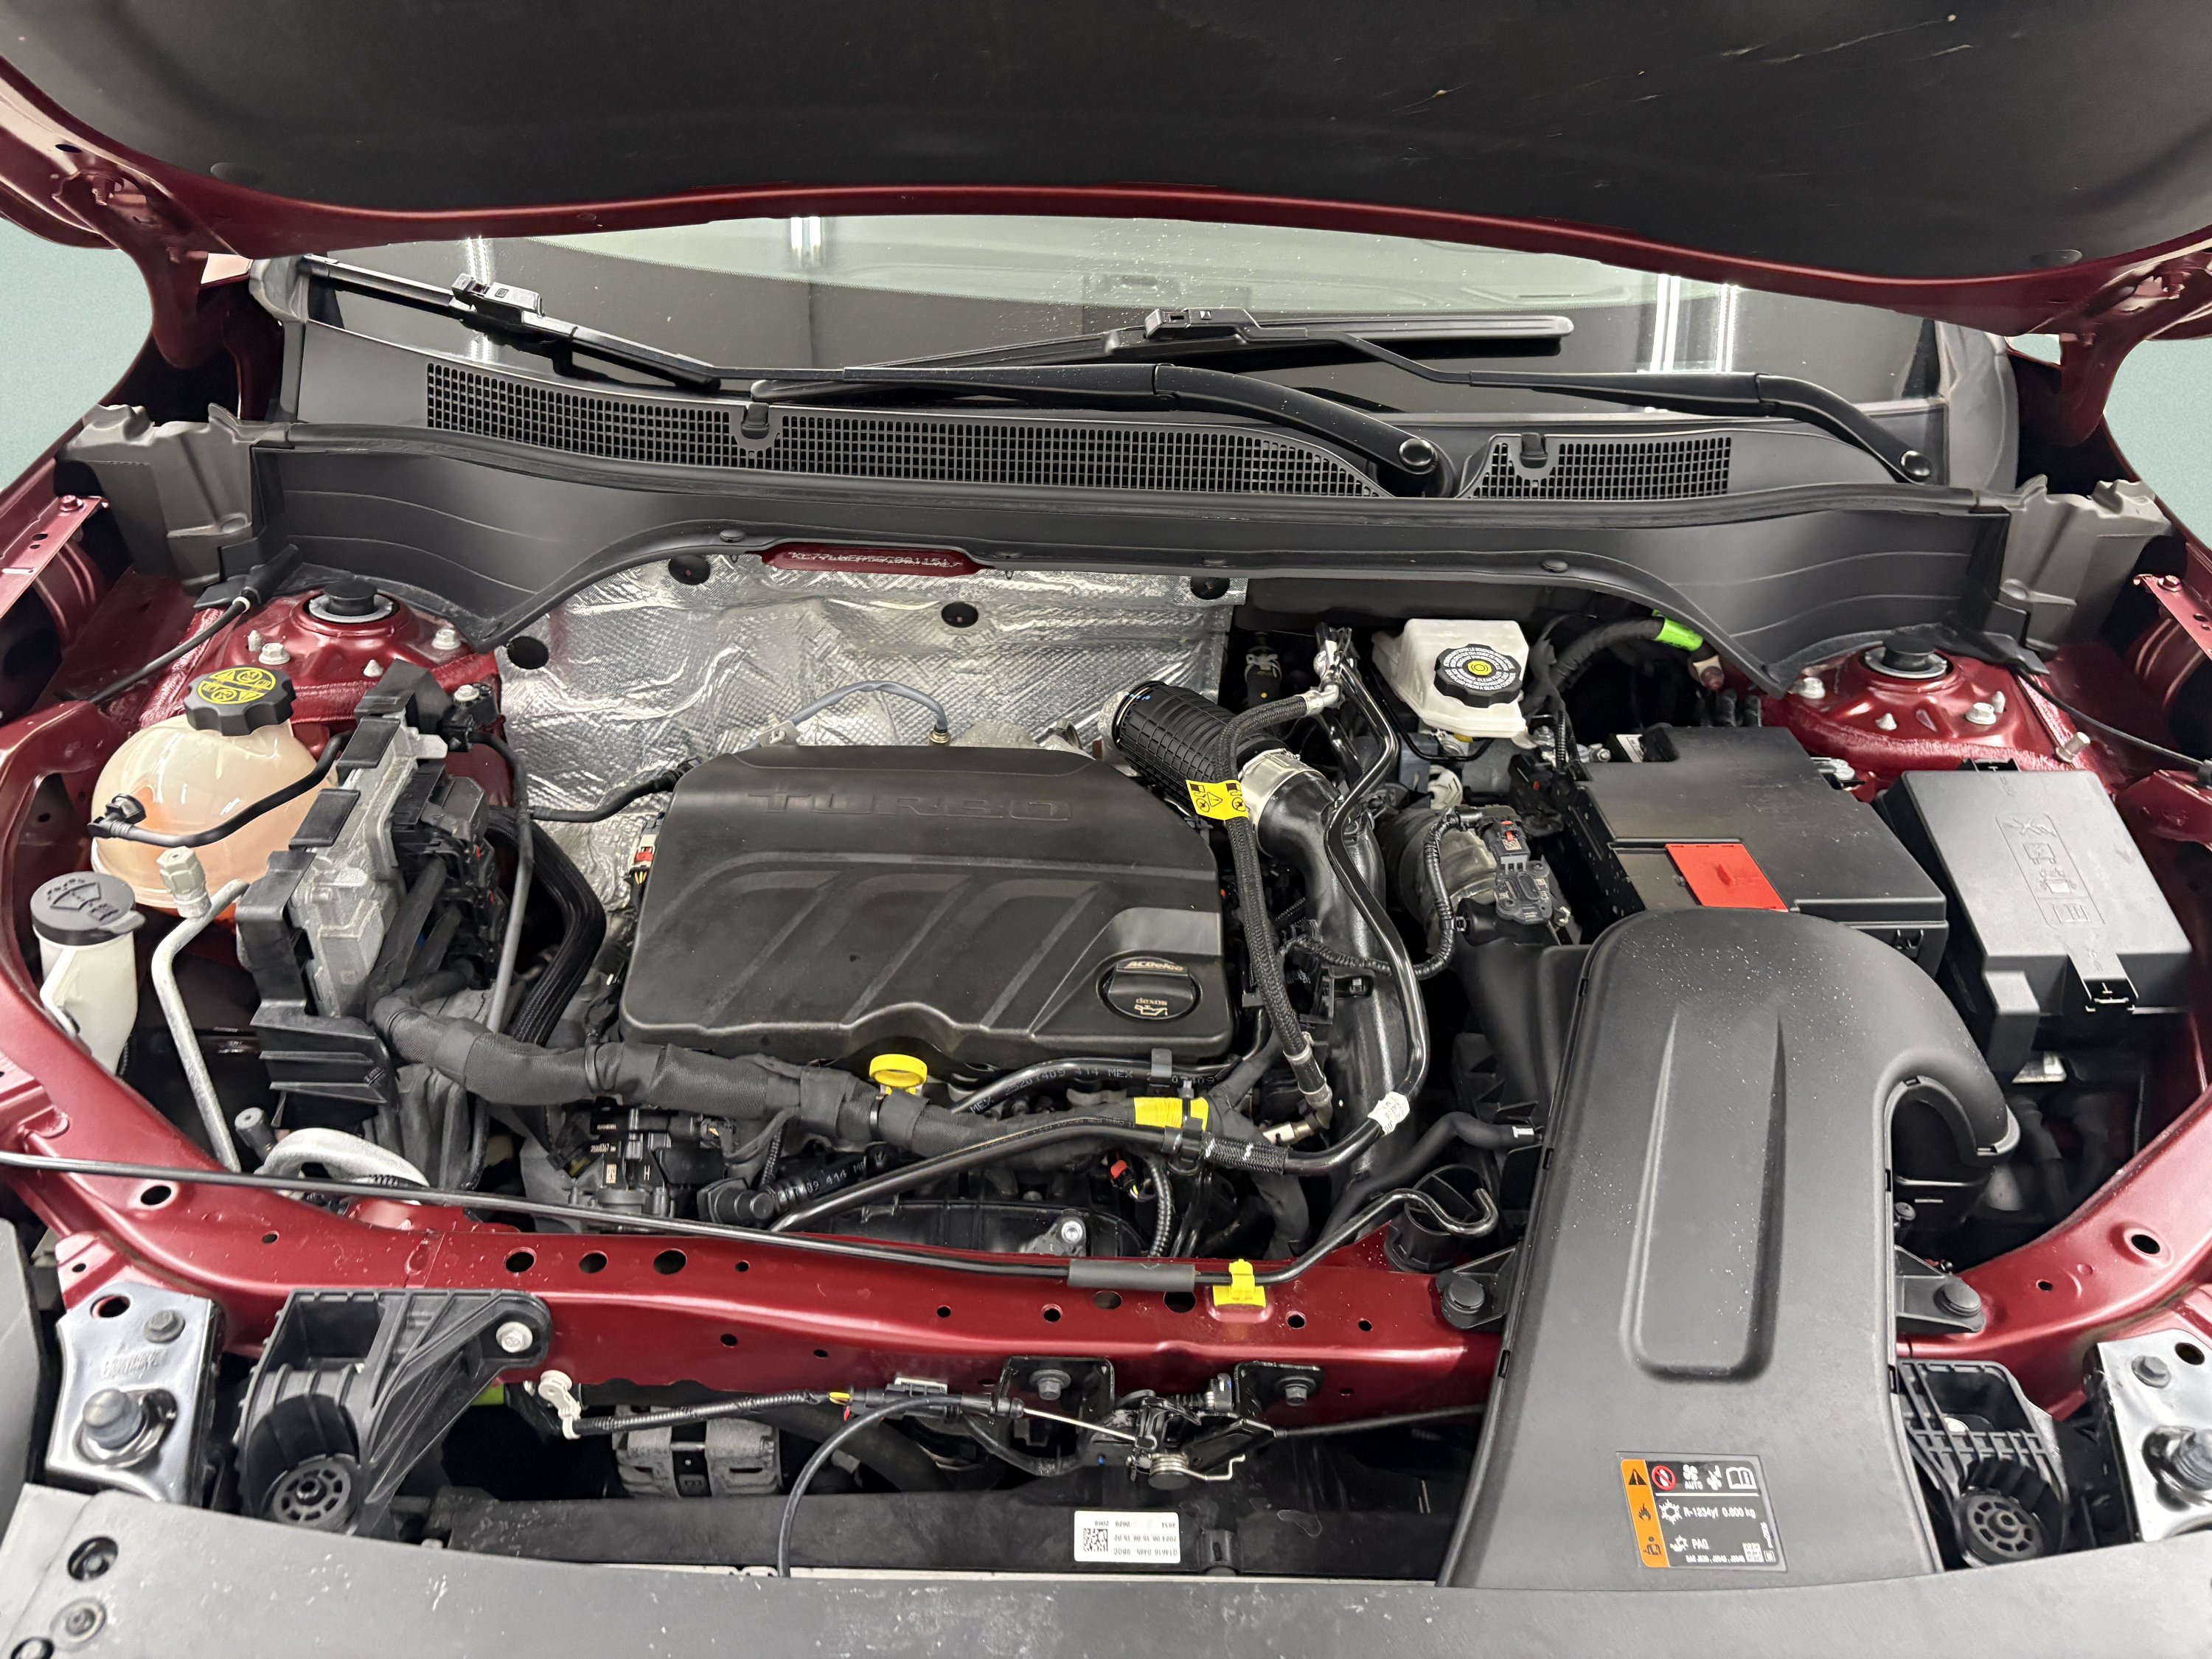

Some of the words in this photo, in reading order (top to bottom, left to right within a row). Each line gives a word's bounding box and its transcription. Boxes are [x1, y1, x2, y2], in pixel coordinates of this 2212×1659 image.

[748, 793, 1071, 821] TURBO
[1125, 961, 1183, 971] ACDelco
[1135, 997, 1168, 1006] dexos
[1108, 1068, 1133, 1078] MEX
[1685, 1481, 1703, 1490] AUTO
[1691, 1538, 1710, 1550] PAG
